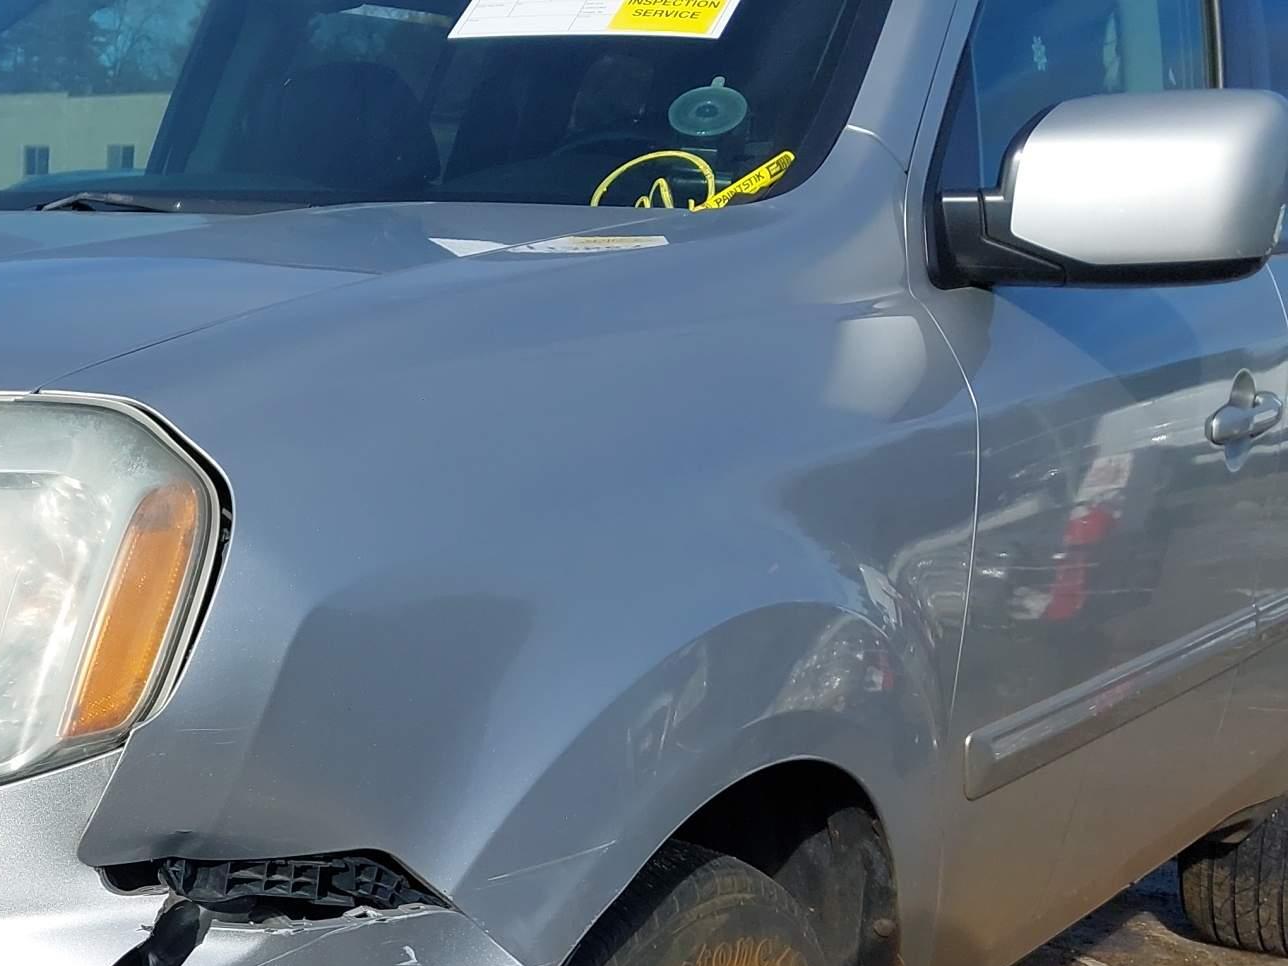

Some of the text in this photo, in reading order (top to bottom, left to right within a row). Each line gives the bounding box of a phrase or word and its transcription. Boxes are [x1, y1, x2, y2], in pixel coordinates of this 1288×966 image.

[627, 0, 720, 9] INSPECTION
[632, 8, 702, 19] SERVICE
[713, 170, 765, 208] PAINTSTIK
